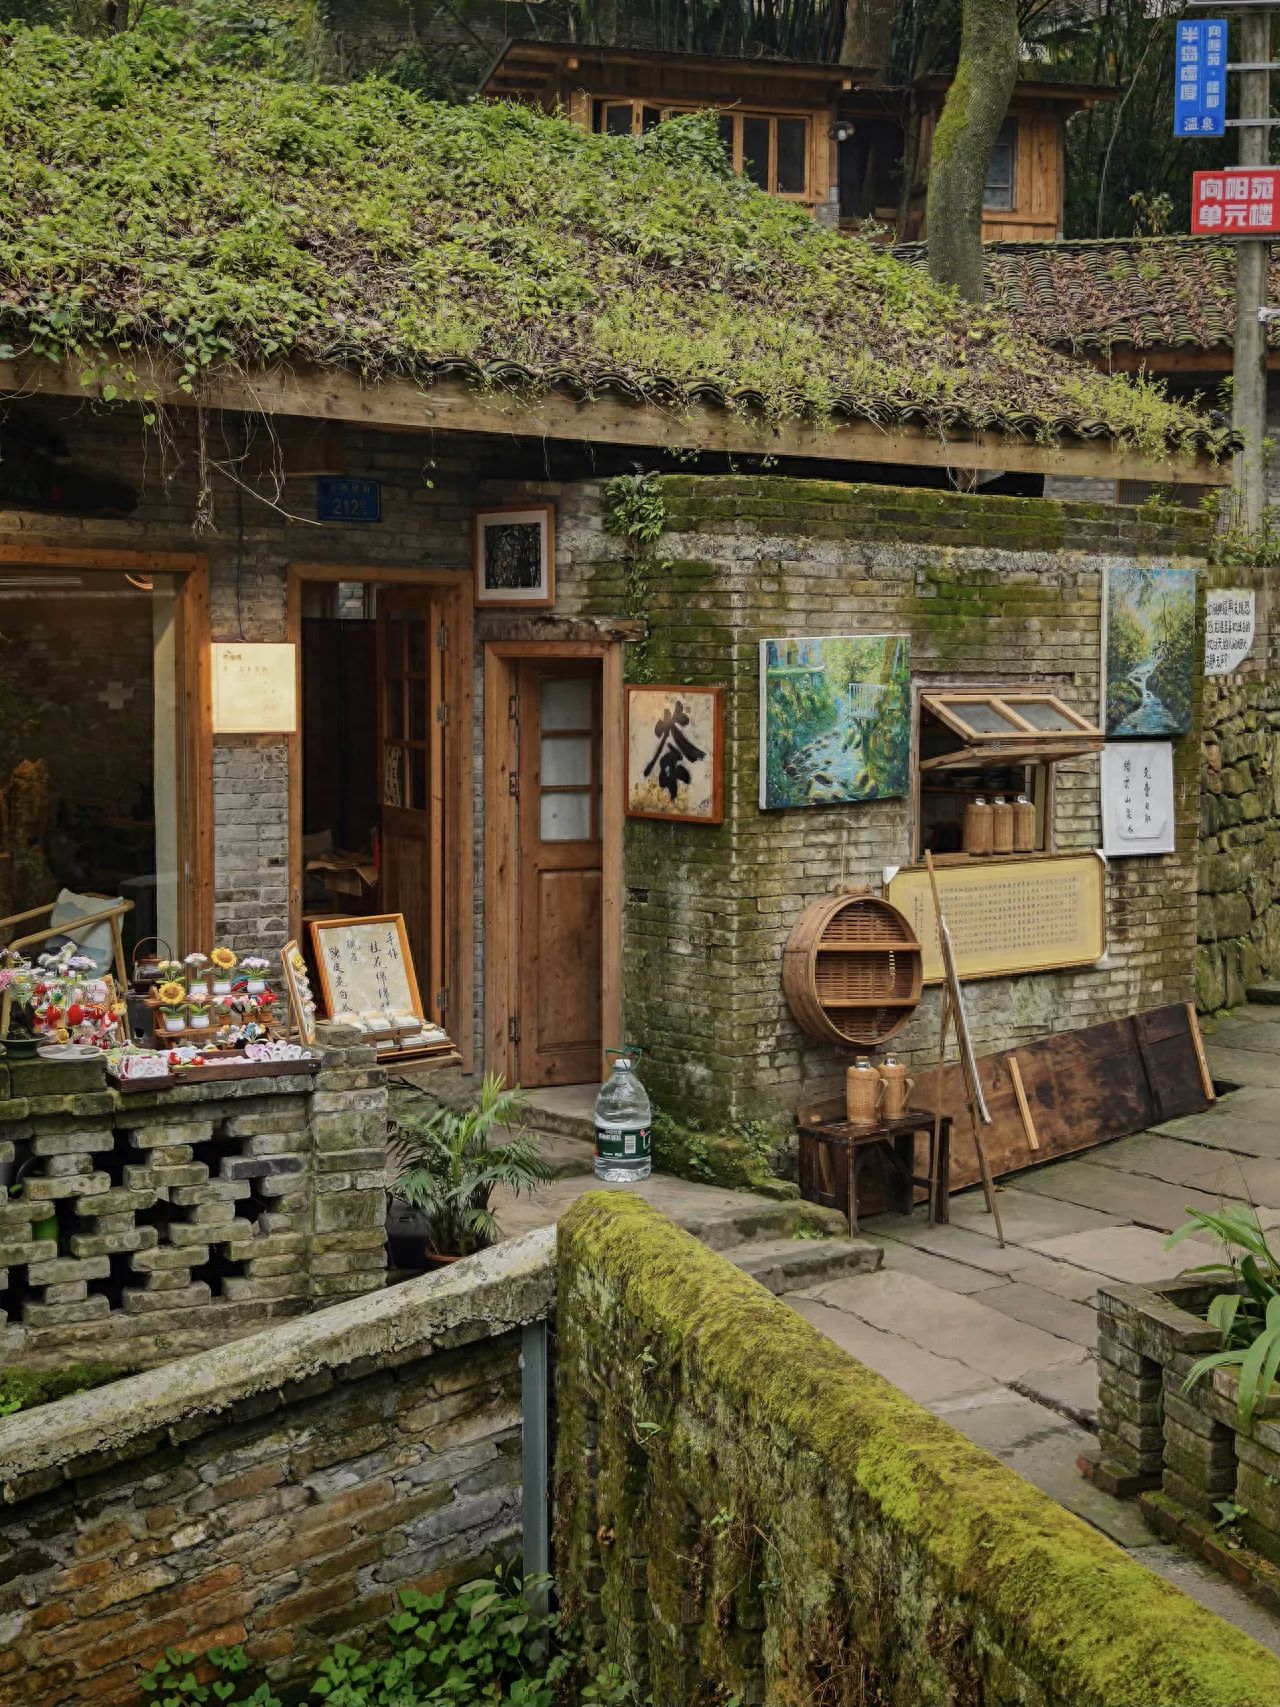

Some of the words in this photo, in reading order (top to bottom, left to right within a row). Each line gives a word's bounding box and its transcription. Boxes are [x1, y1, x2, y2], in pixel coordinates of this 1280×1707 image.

[1184, 117, 1214, 131] 温泉
[1200, 177, 1274, 200] 向阳苑
[1199, 203, 1273, 227] 单元楼
[387, 932, 398, 959] 手作
